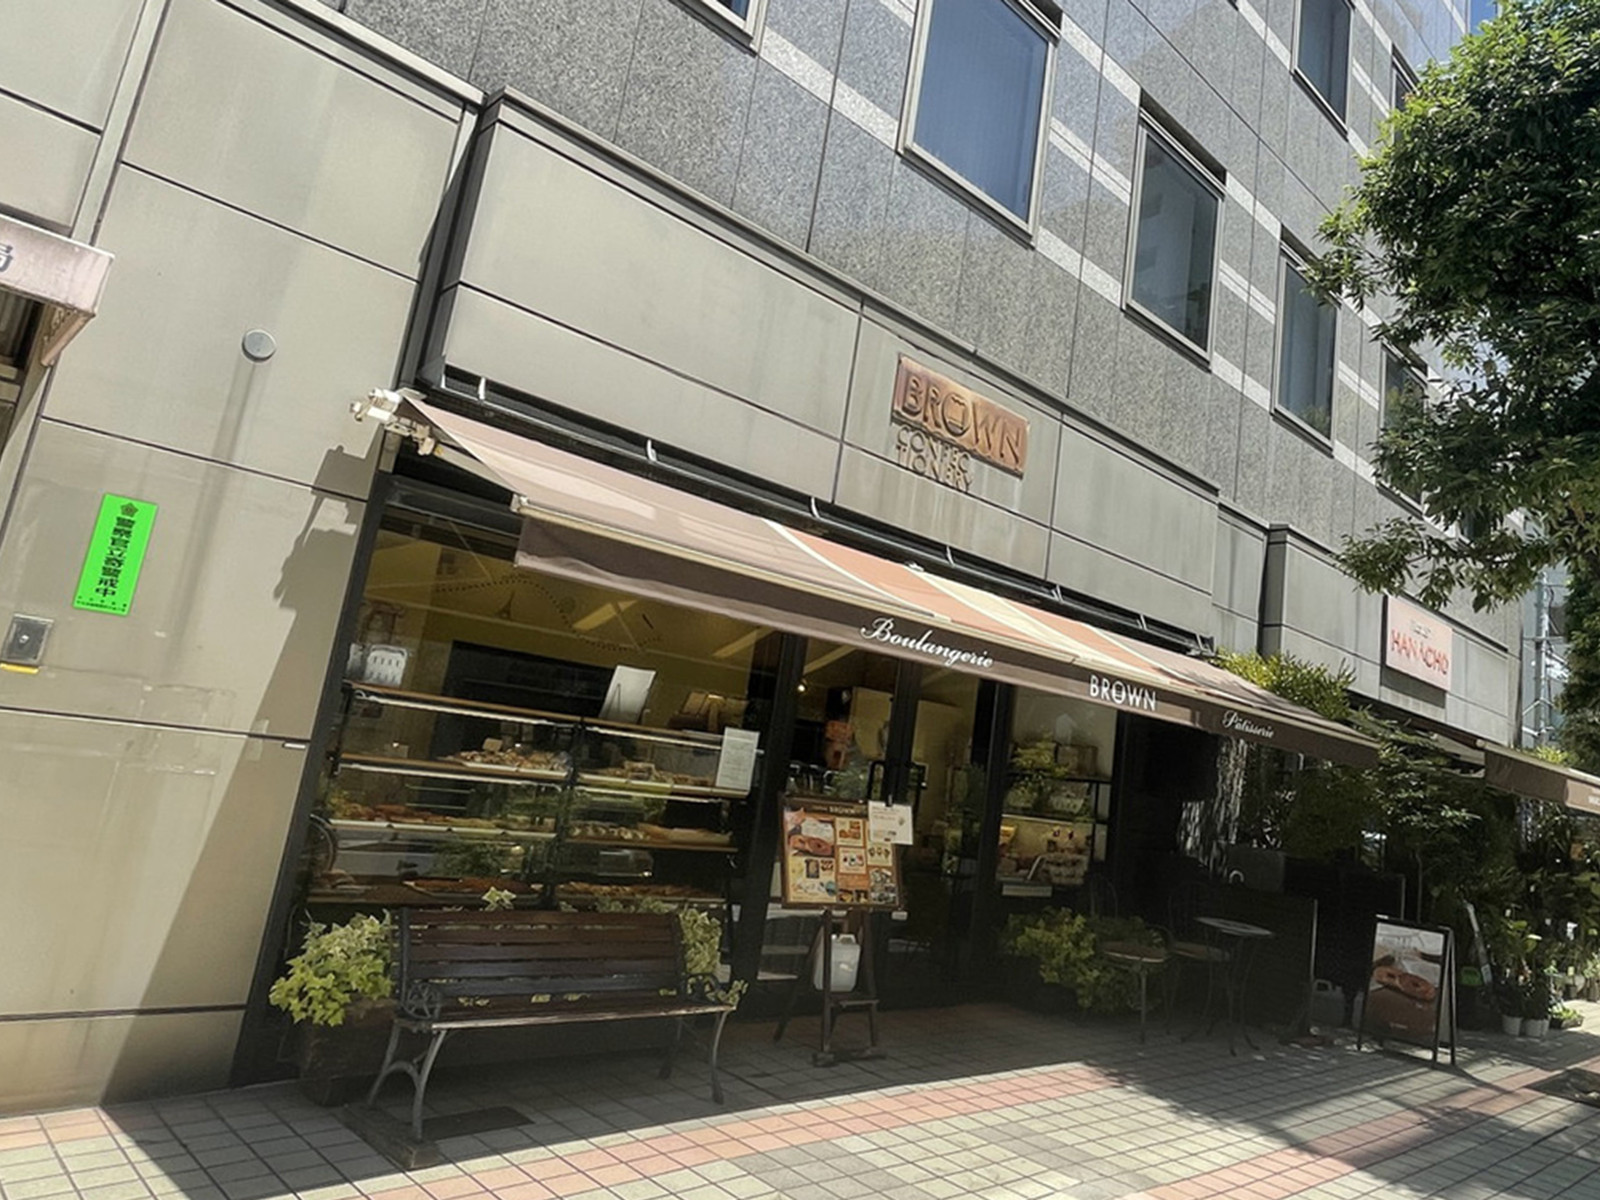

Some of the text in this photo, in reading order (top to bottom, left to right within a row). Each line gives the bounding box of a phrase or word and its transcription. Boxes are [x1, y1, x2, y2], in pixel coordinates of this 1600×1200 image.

[902, 372, 1020, 467] BROWN
[860, 617, 994, 668] Boulangerie
[1089, 674, 1157, 711] BROWN
